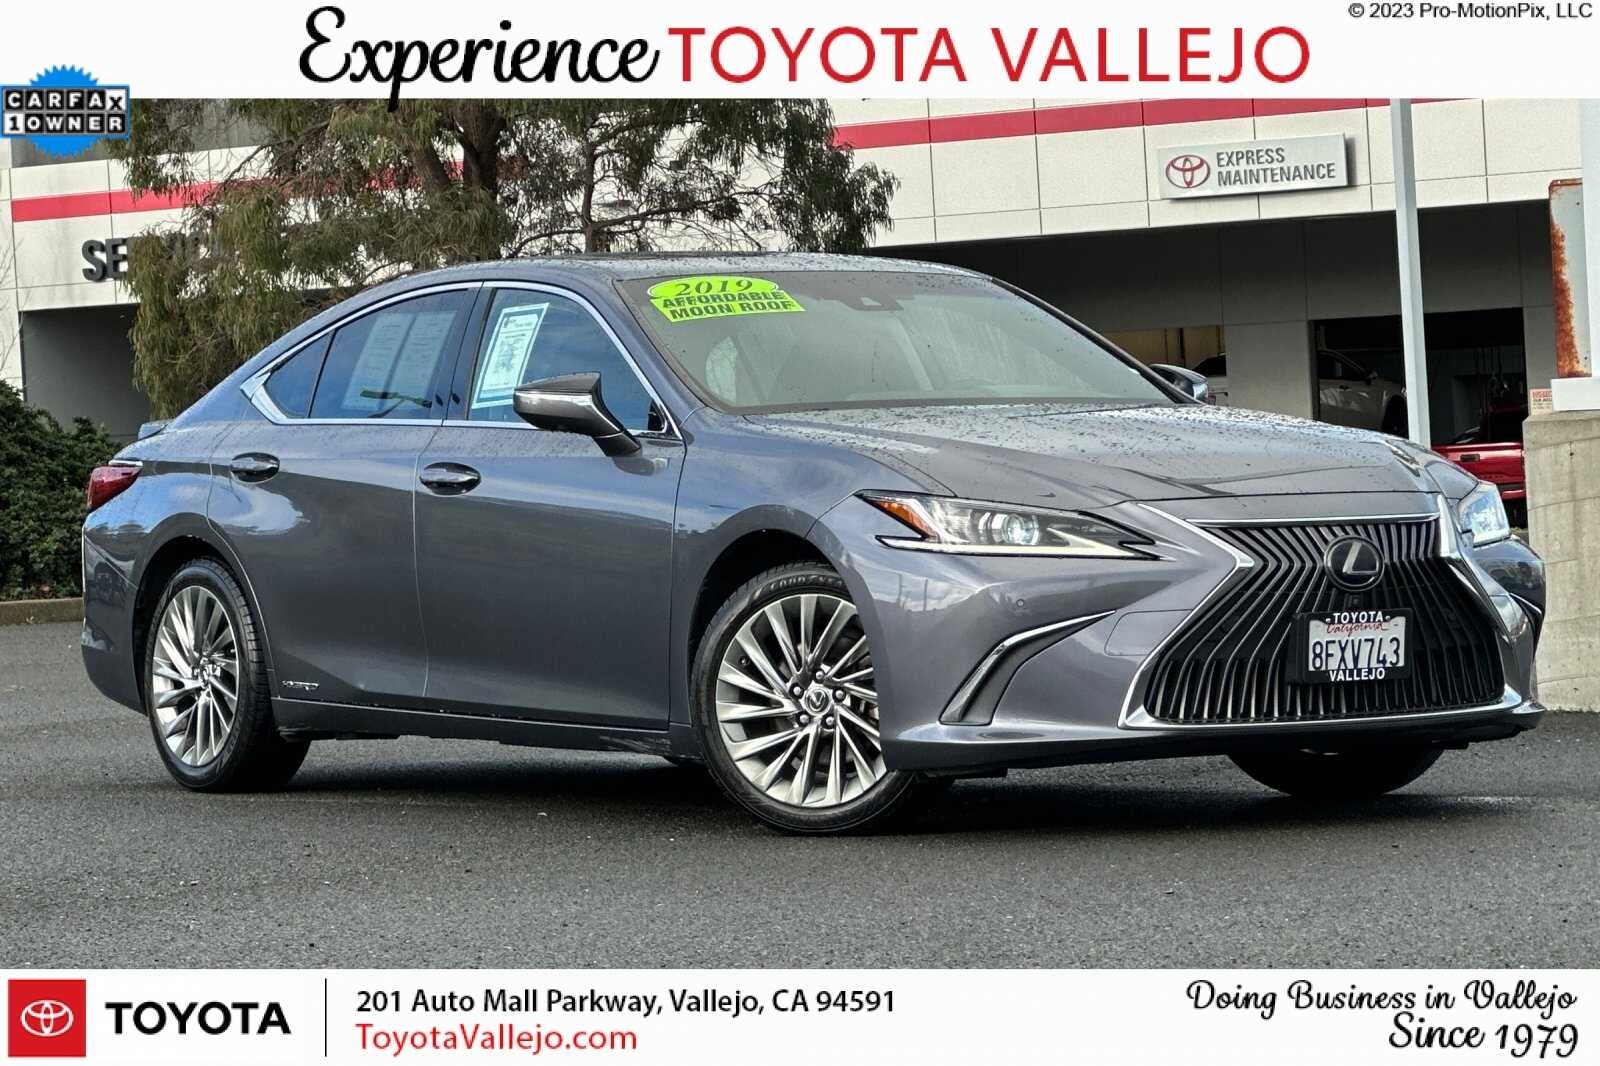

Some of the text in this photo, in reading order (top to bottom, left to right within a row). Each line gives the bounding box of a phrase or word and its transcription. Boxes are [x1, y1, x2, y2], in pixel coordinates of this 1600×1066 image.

[1216, 147, 1285, 168] EXPRESS
[1217, 163, 1336, 187] MAINTENANCE
[675, 279, 753, 297] 2019
[663, 291, 786, 309] AFFORDABLE
[669, 300, 795, 320] MOON ROOF
[1333, 611, 1384, 624] TOYOTA
[1327, 623, 1389, 637] California
[1312, 637, 1400, 670] 8FXV743
[1329, 667, 1386, 682] VALLEJO
